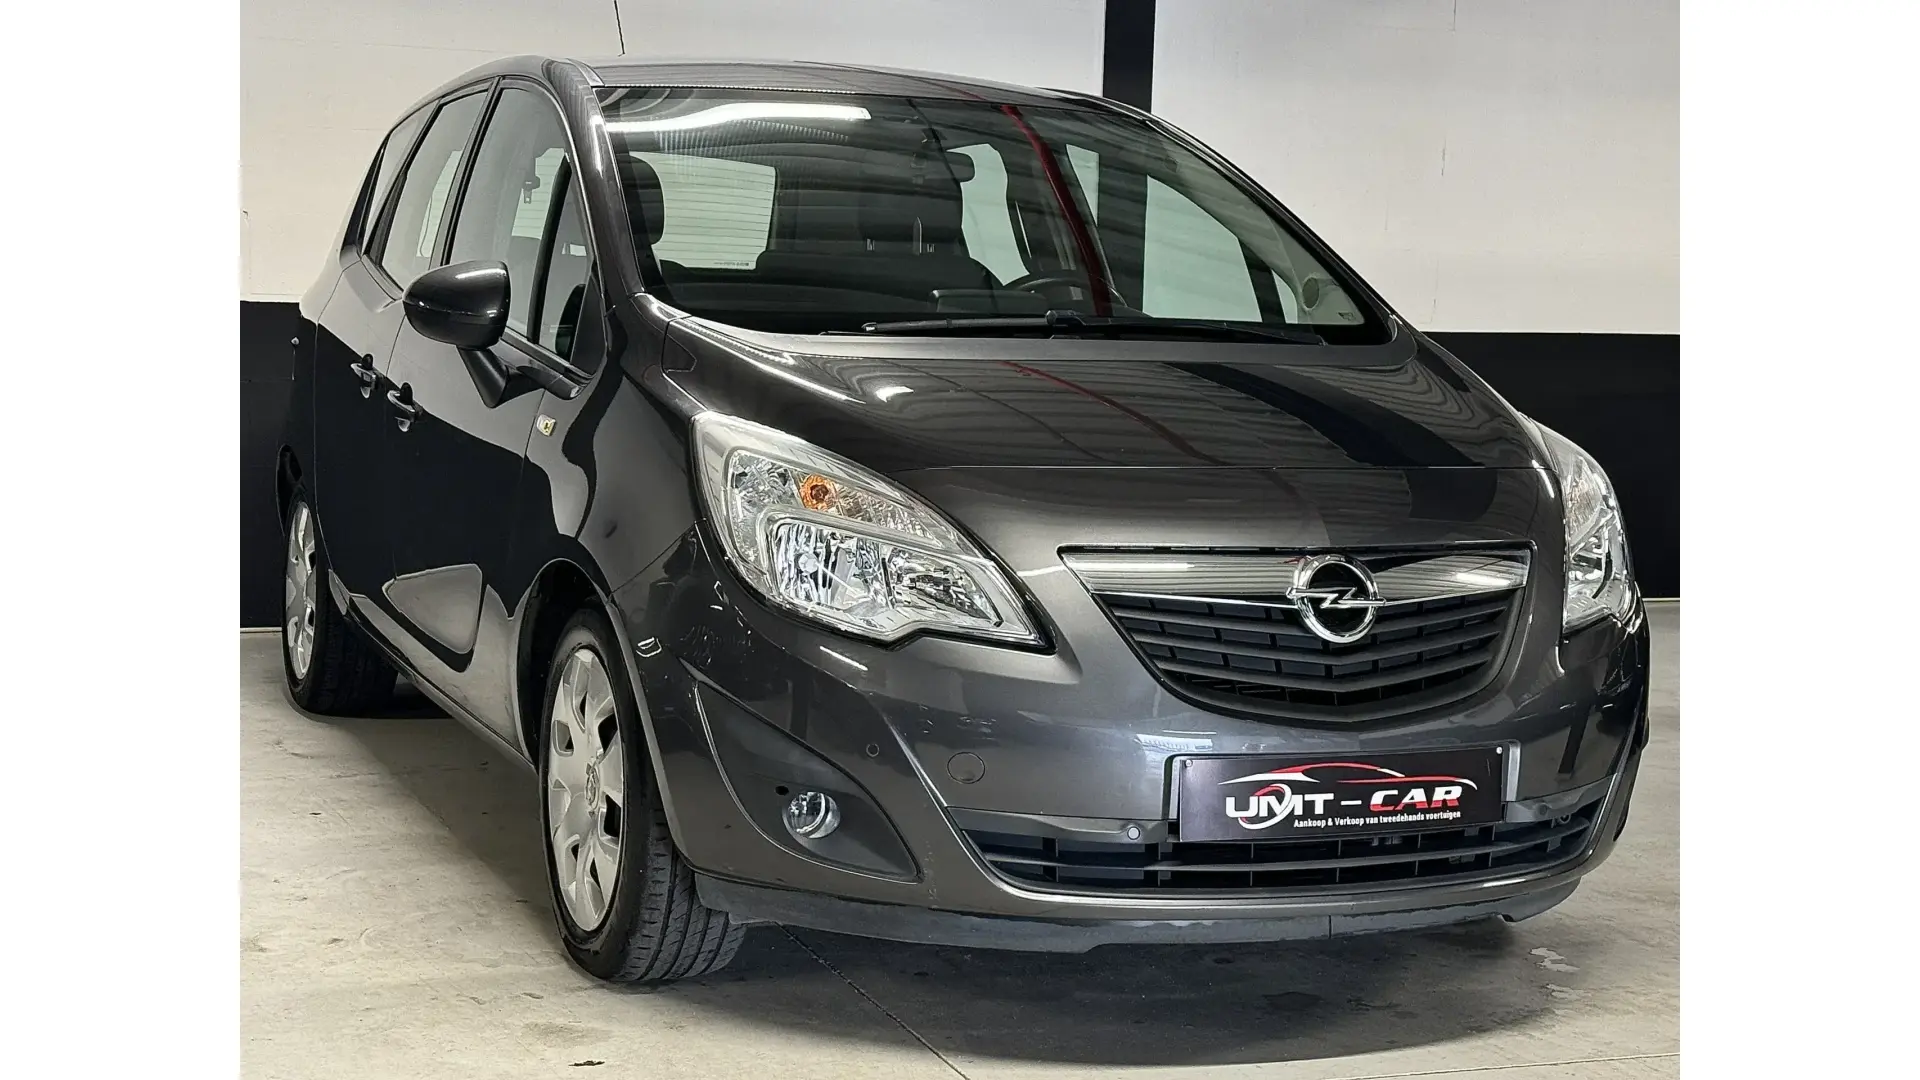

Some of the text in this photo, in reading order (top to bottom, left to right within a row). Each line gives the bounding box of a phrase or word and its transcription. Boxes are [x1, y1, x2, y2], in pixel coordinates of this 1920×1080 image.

[1369, 785, 1463, 812] CAR
[1293, 810, 1461, 829] Aankoop & Verkoop van tweedehands voertuigen
